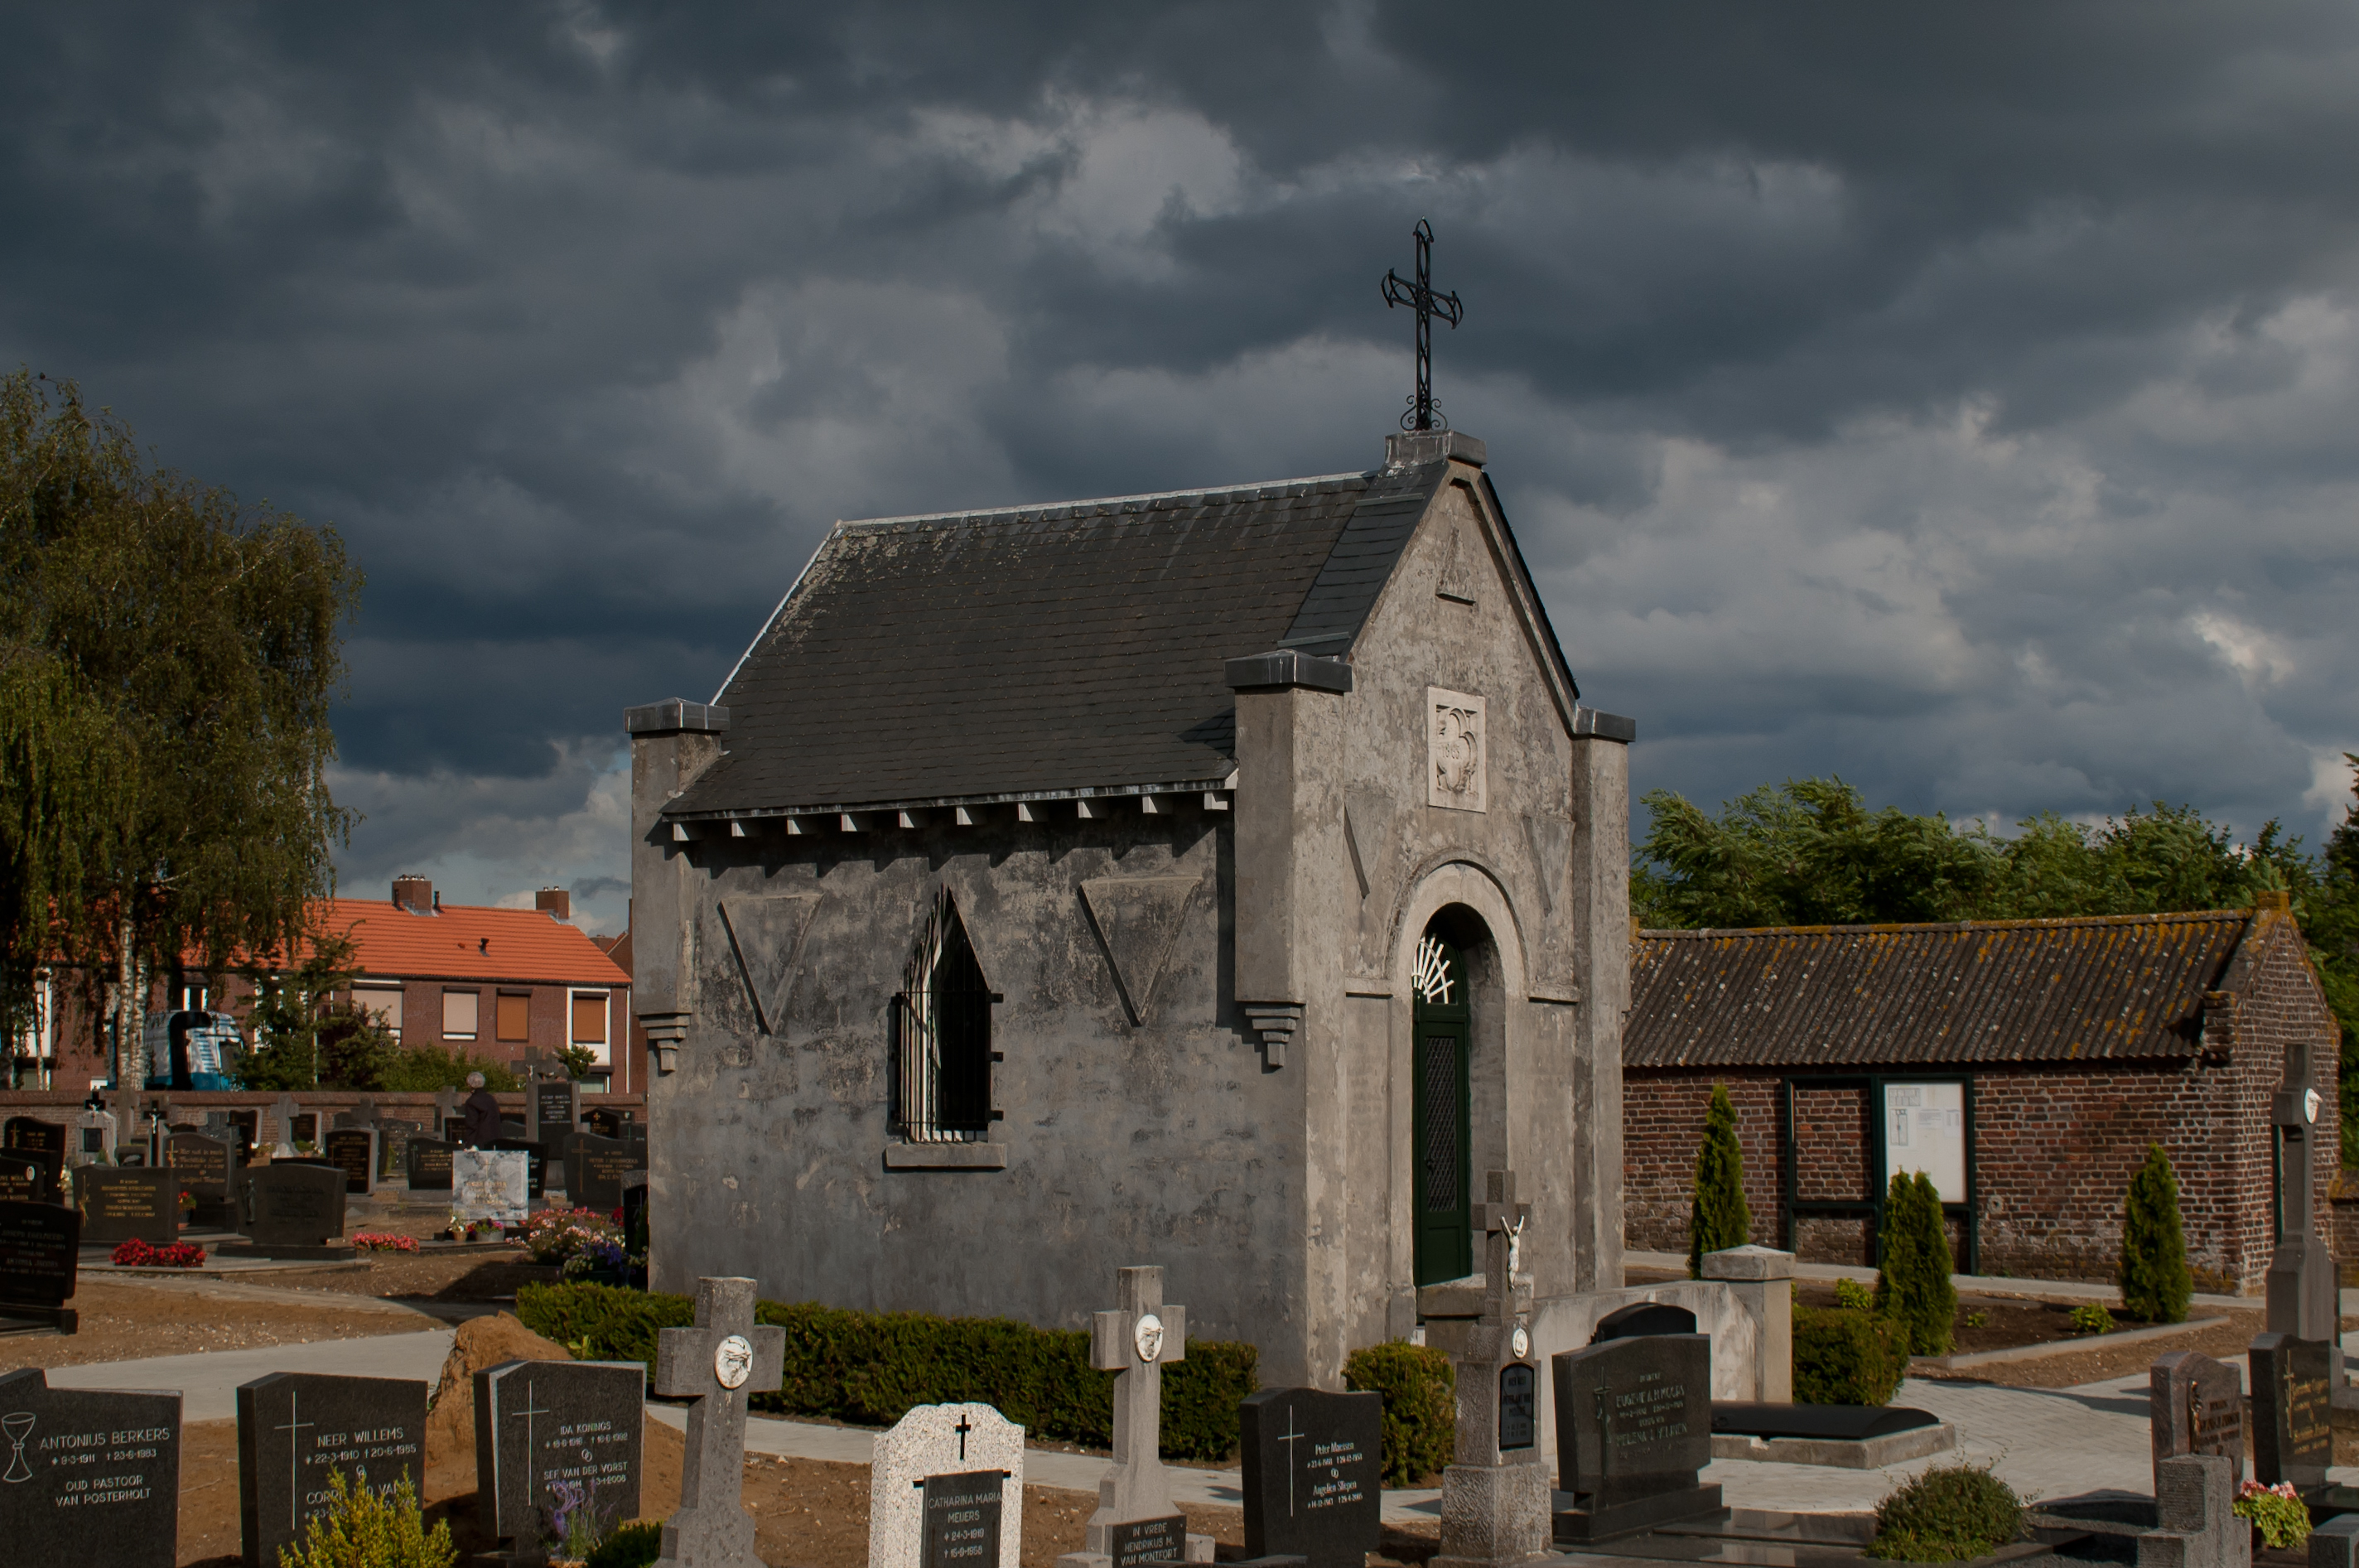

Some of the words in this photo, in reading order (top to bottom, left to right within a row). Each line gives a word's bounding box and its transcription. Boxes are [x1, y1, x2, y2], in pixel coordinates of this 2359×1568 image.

[316, 1432, 347, 1448] NEER
[354, 1426, 404, 1444] WILLEMS
[560, 1425, 573, 1435] IDA
[576, 1421, 611, 1434] KONINGS
[39, 1432, 106, 1450] ANTONIUS
[111, 1427, 171, 1445] BERKERS
[562, 1467, 580, 1479] VAN
[582, 1464, 598, 1476] DER
[601, 1461, 628, 1474] VORST
[65, 1480, 89, 1492] OUD
[94, 1474, 143, 1489] PASTOOR
[55, 1494, 79, 1508] VAN
[84, 1487, 152, 1505] POSTERHOLT
[306, 1487, 348, 1505] CORRI
[929, 1493, 974, 1509] CATHARINA
[976, 1491, 1003, 1504] MARIA
[1132, 1526, 1141, 1537] IN
[1144, 1522, 1168, 1536] VREDE
[1124, 1537, 1164, 1553] HENDRIKUS
[1165, 1535, 1175, 1547] M.
[1120, 1554, 1136, 1567] VAN
[1138, 1546, 1178, 1565] MONTFORT
